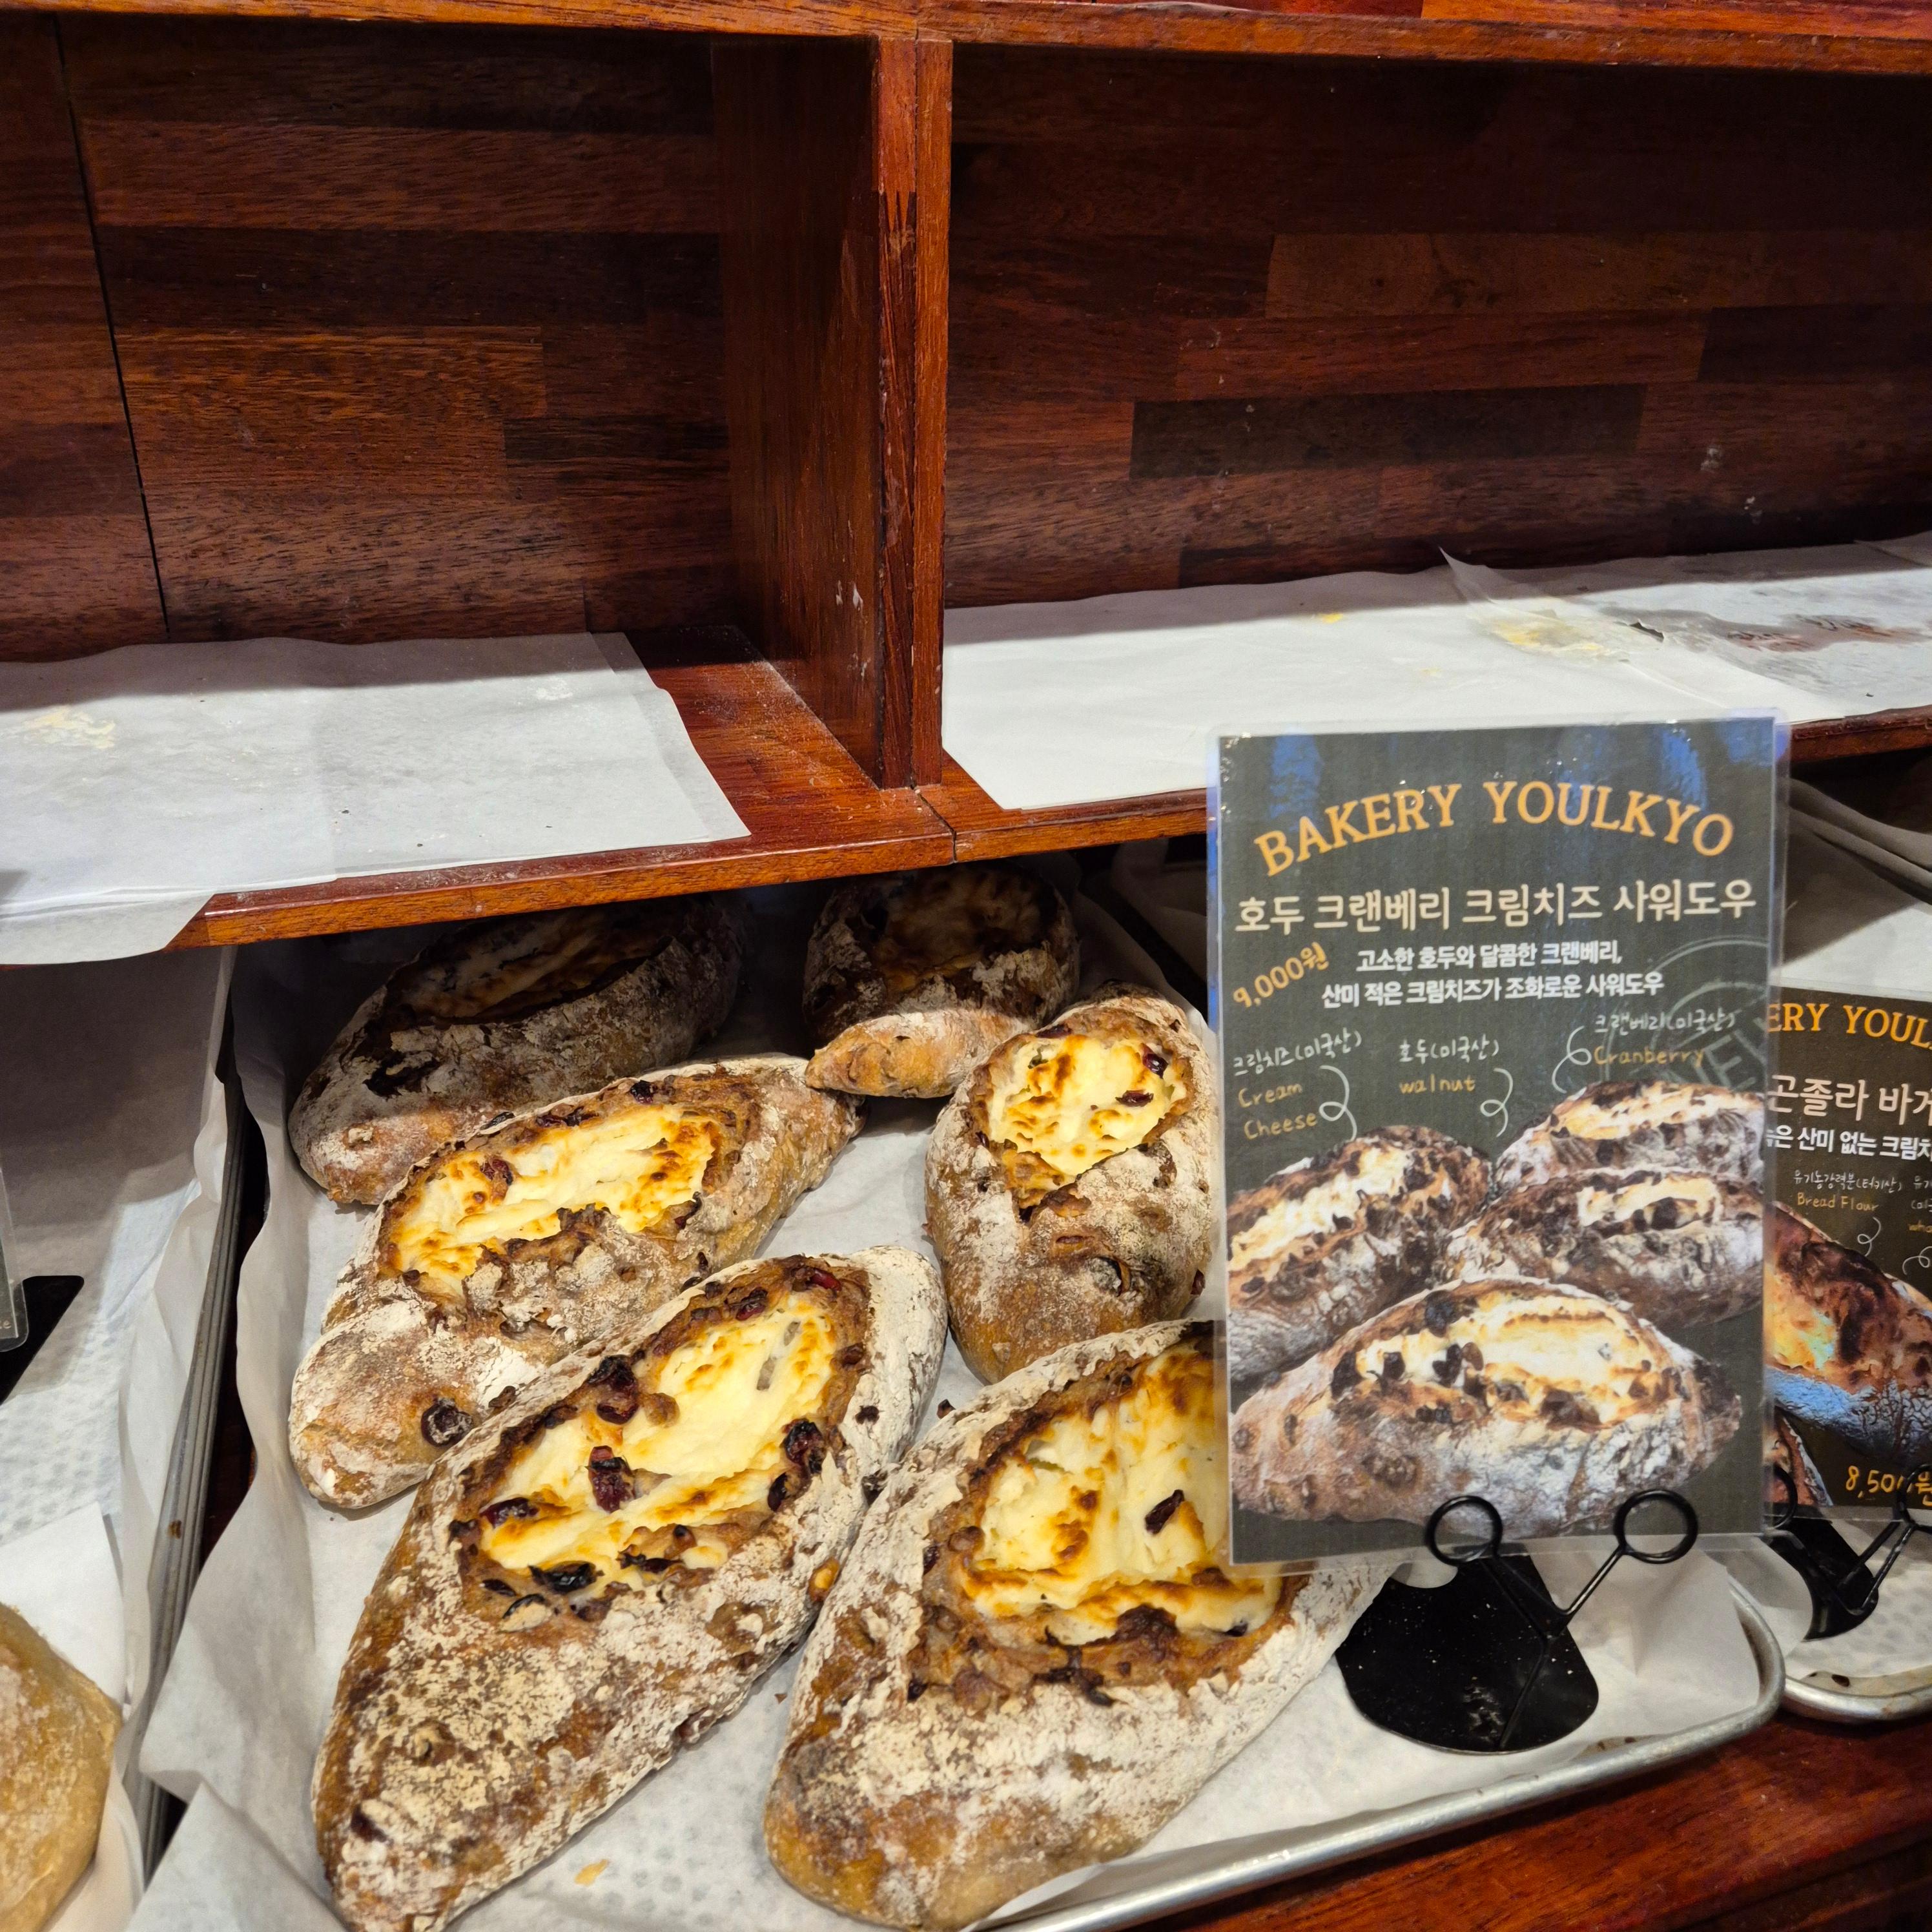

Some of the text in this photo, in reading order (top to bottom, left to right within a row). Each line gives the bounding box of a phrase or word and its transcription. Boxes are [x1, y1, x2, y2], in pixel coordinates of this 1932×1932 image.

[1255, 780, 1734, 877] BAKERY YOULKYO
[1235, 878, 1756, 936] 호두 크랜베리 크림치즈 사워도우
[1357, 940, 1623, 972] 고소한 호두와 달콤한 크랜베리,
[1233, 941, 1329, 1008] 9,000원
[1322, 972, 1665, 1009] 산미 적은 크림치즈가 조화로운 사워도우
[1842, 1005, 1932, 1049] YOUL
[1594, 1045, 1705, 1068] Cranberry
[1238, 1083, 1304, 1109] Cream
[1399, 1074, 1476, 1094] walnut
[1244, 1111, 1318, 1141] Cheese
[1798, 1127, 1834, 1153] 산미
[1840, 1131, 1878, 1156] 없는
[1797, 1192, 1880, 1211] Bread Flour
